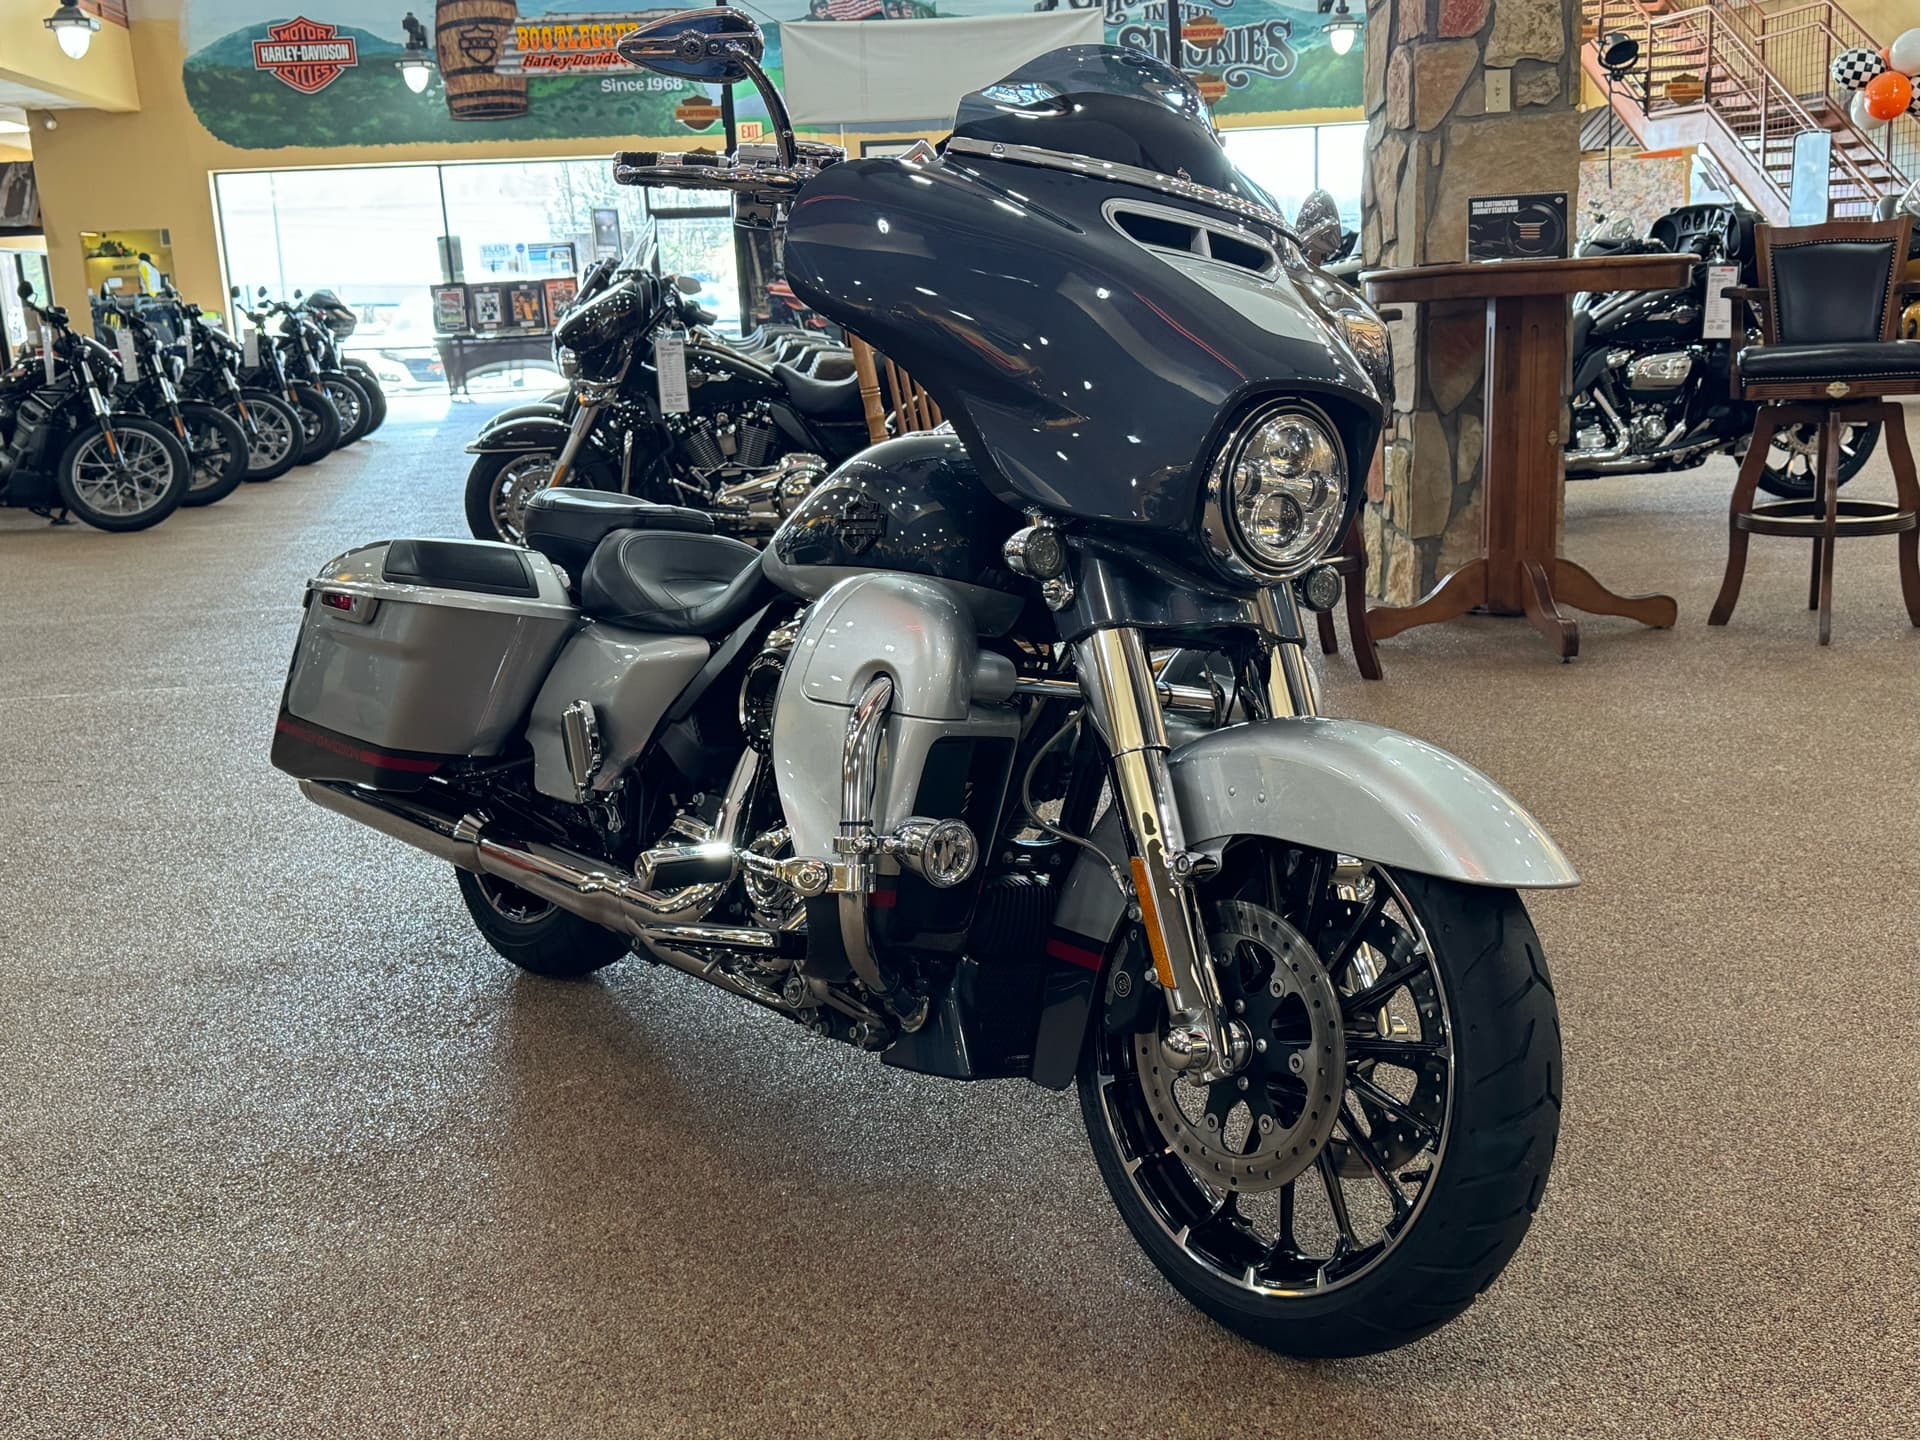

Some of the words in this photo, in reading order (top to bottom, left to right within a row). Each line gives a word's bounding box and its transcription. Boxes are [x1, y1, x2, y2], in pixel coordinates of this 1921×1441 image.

[1144, 4, 1165, 20] IN
[280, 25, 326, 40] MOTOR
[516, 22, 639, 51] BOOTLEGGE
[261, 44, 350, 62] HARLEY-DAVIDSON
[522, 51, 630, 71] Harley-Davids
[283, 65, 330, 86] CYCLES
[601, 78, 645, 93] Since
[646, 77, 684, 92] 1968
[741, 124, 759, 138] EXIT
